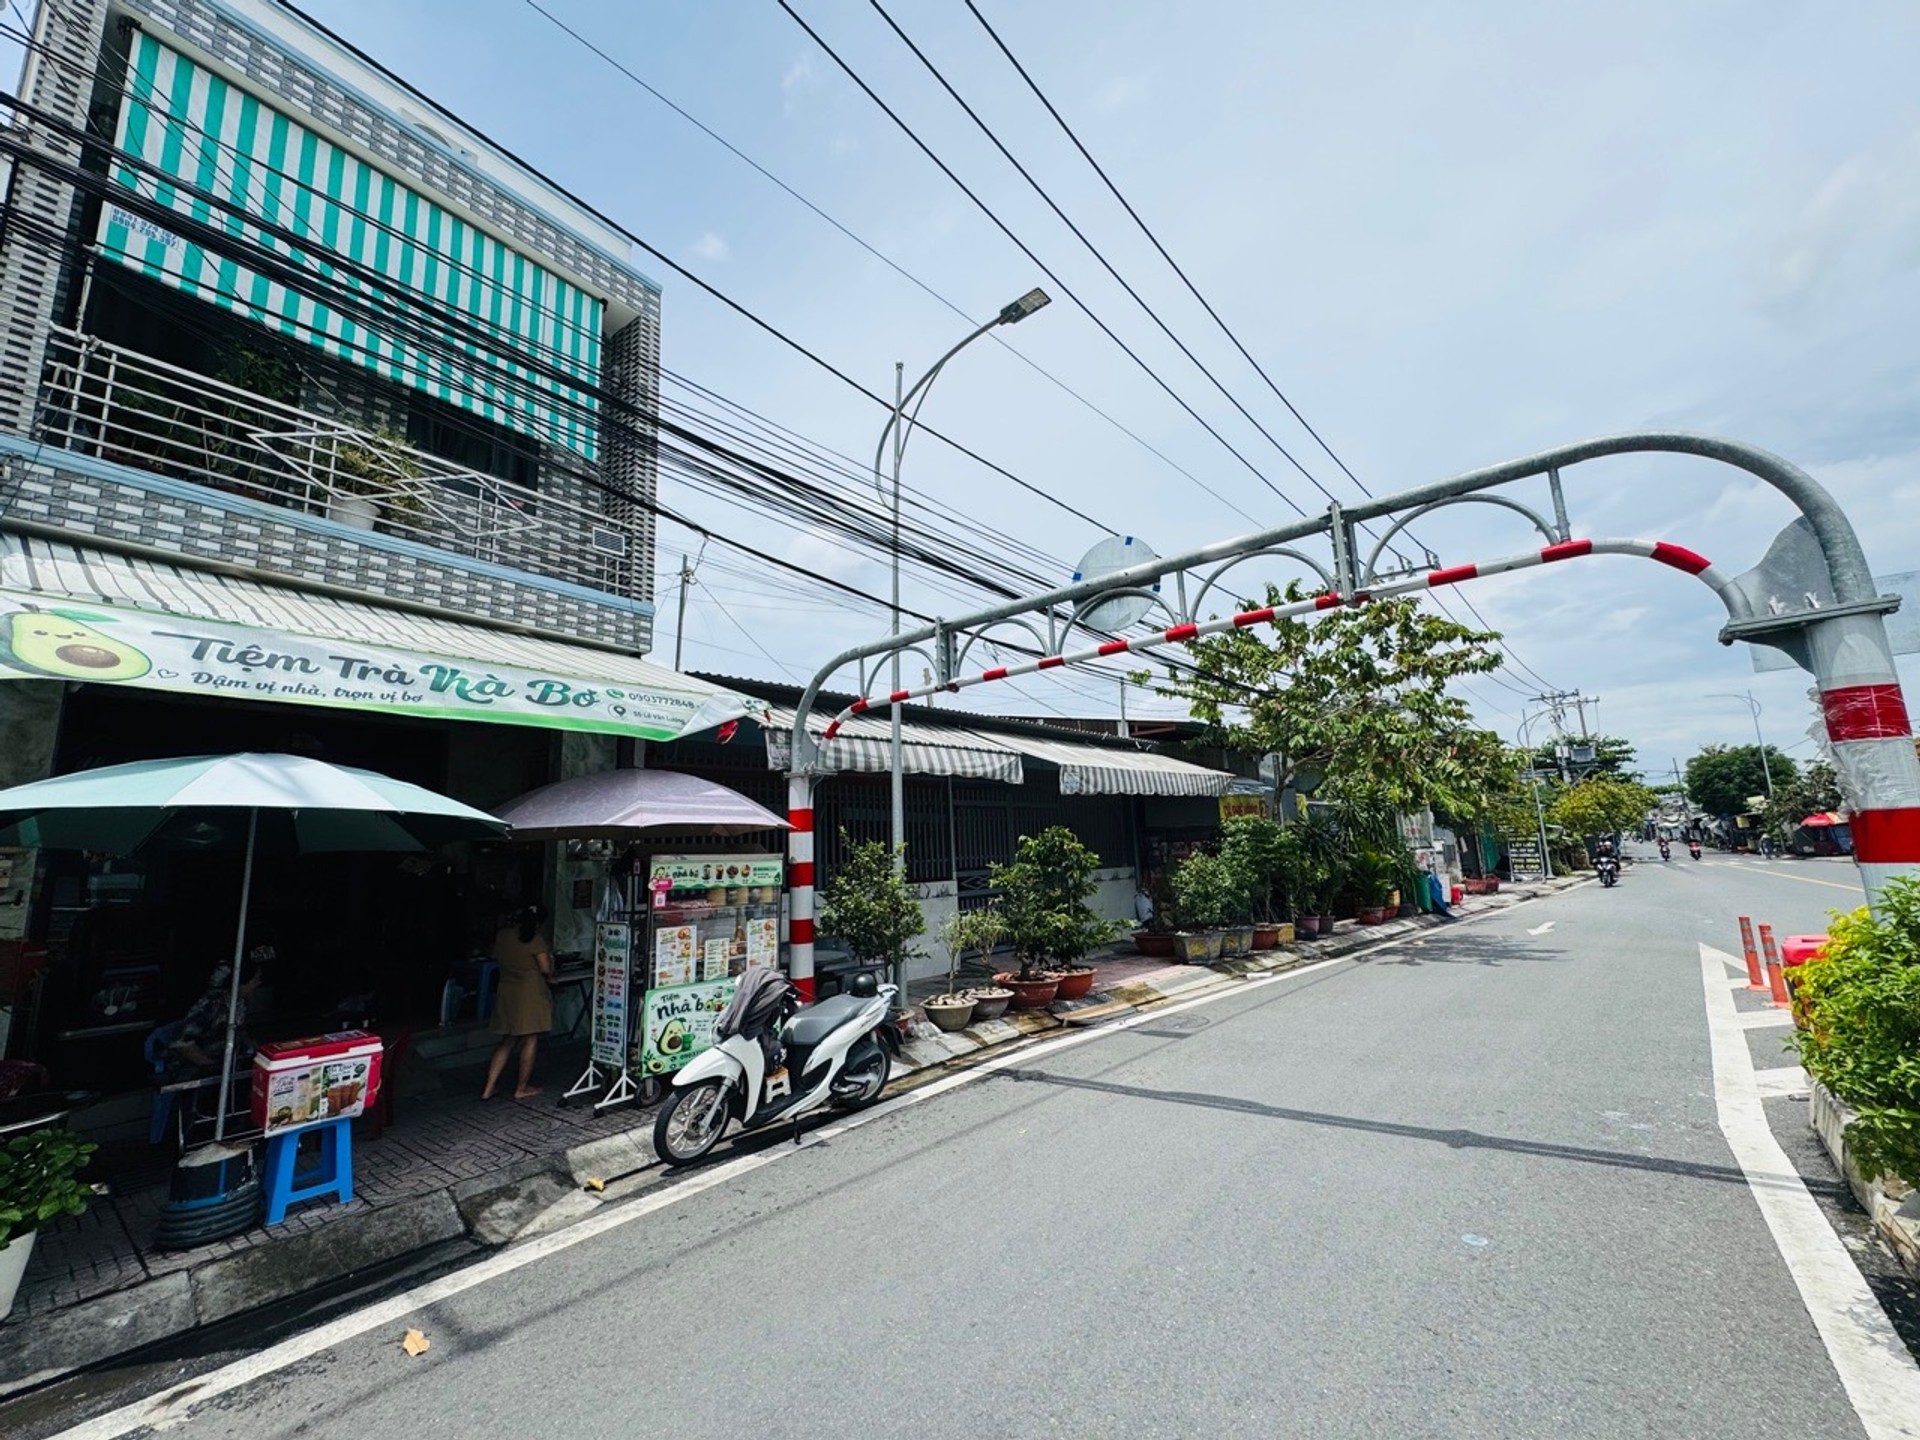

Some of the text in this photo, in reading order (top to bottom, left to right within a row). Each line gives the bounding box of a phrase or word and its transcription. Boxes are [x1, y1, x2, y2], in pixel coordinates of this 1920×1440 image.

[151, 630, 601, 708] Tiệm Trà Nhà Bơ
[191, 671, 424, 703] Đậm vị nhà, trọn vị bơ
